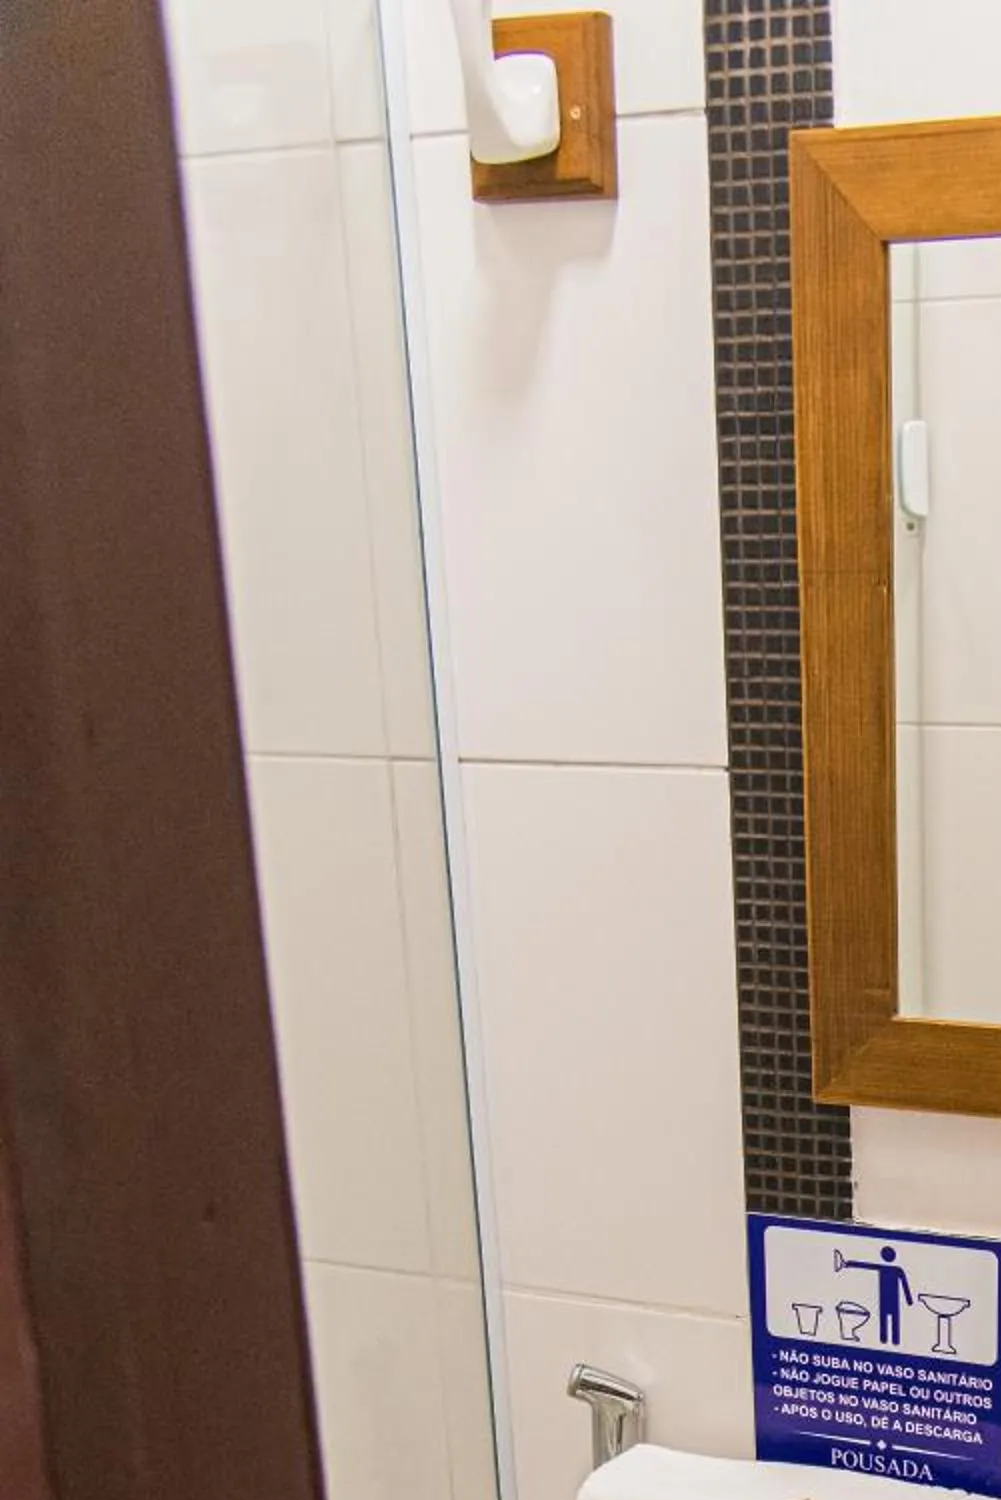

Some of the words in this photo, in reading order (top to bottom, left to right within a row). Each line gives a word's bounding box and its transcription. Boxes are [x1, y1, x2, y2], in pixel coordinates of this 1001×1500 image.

[780, 1349, 809, 1364] NÃO
[812, 1354, 850, 1369] SUBA
[853, 1360, 873, 1373] NO
[876, 1364, 914, 1379] VASO
[917, 1369, 992, 1391] SANITÁRIO
[780, 1366, 810, 1382] NÃO
[813, 1372, 859, 1389] JOGUE
[863, 1379, 906, 1397] PAPEL
[909, 1386, 930, 1400] OU
[933, 1389, 992, 1409] OUTROS
[773, 1384, 835, 1404] OBJETOS
[839, 1394, 859, 1407] NO
[862, 1397, 899, 1413] VASO
[902, 1403, 977, 1425] SANITÁRIO
[821, 1409, 832, 1420] O
[835, 1411, 867, 1428] USO,
[893, 1419, 903, 1431] A
[905, 1421, 983, 1445] DESCARGA
[831, 1448, 933, 1481] POUSADA
